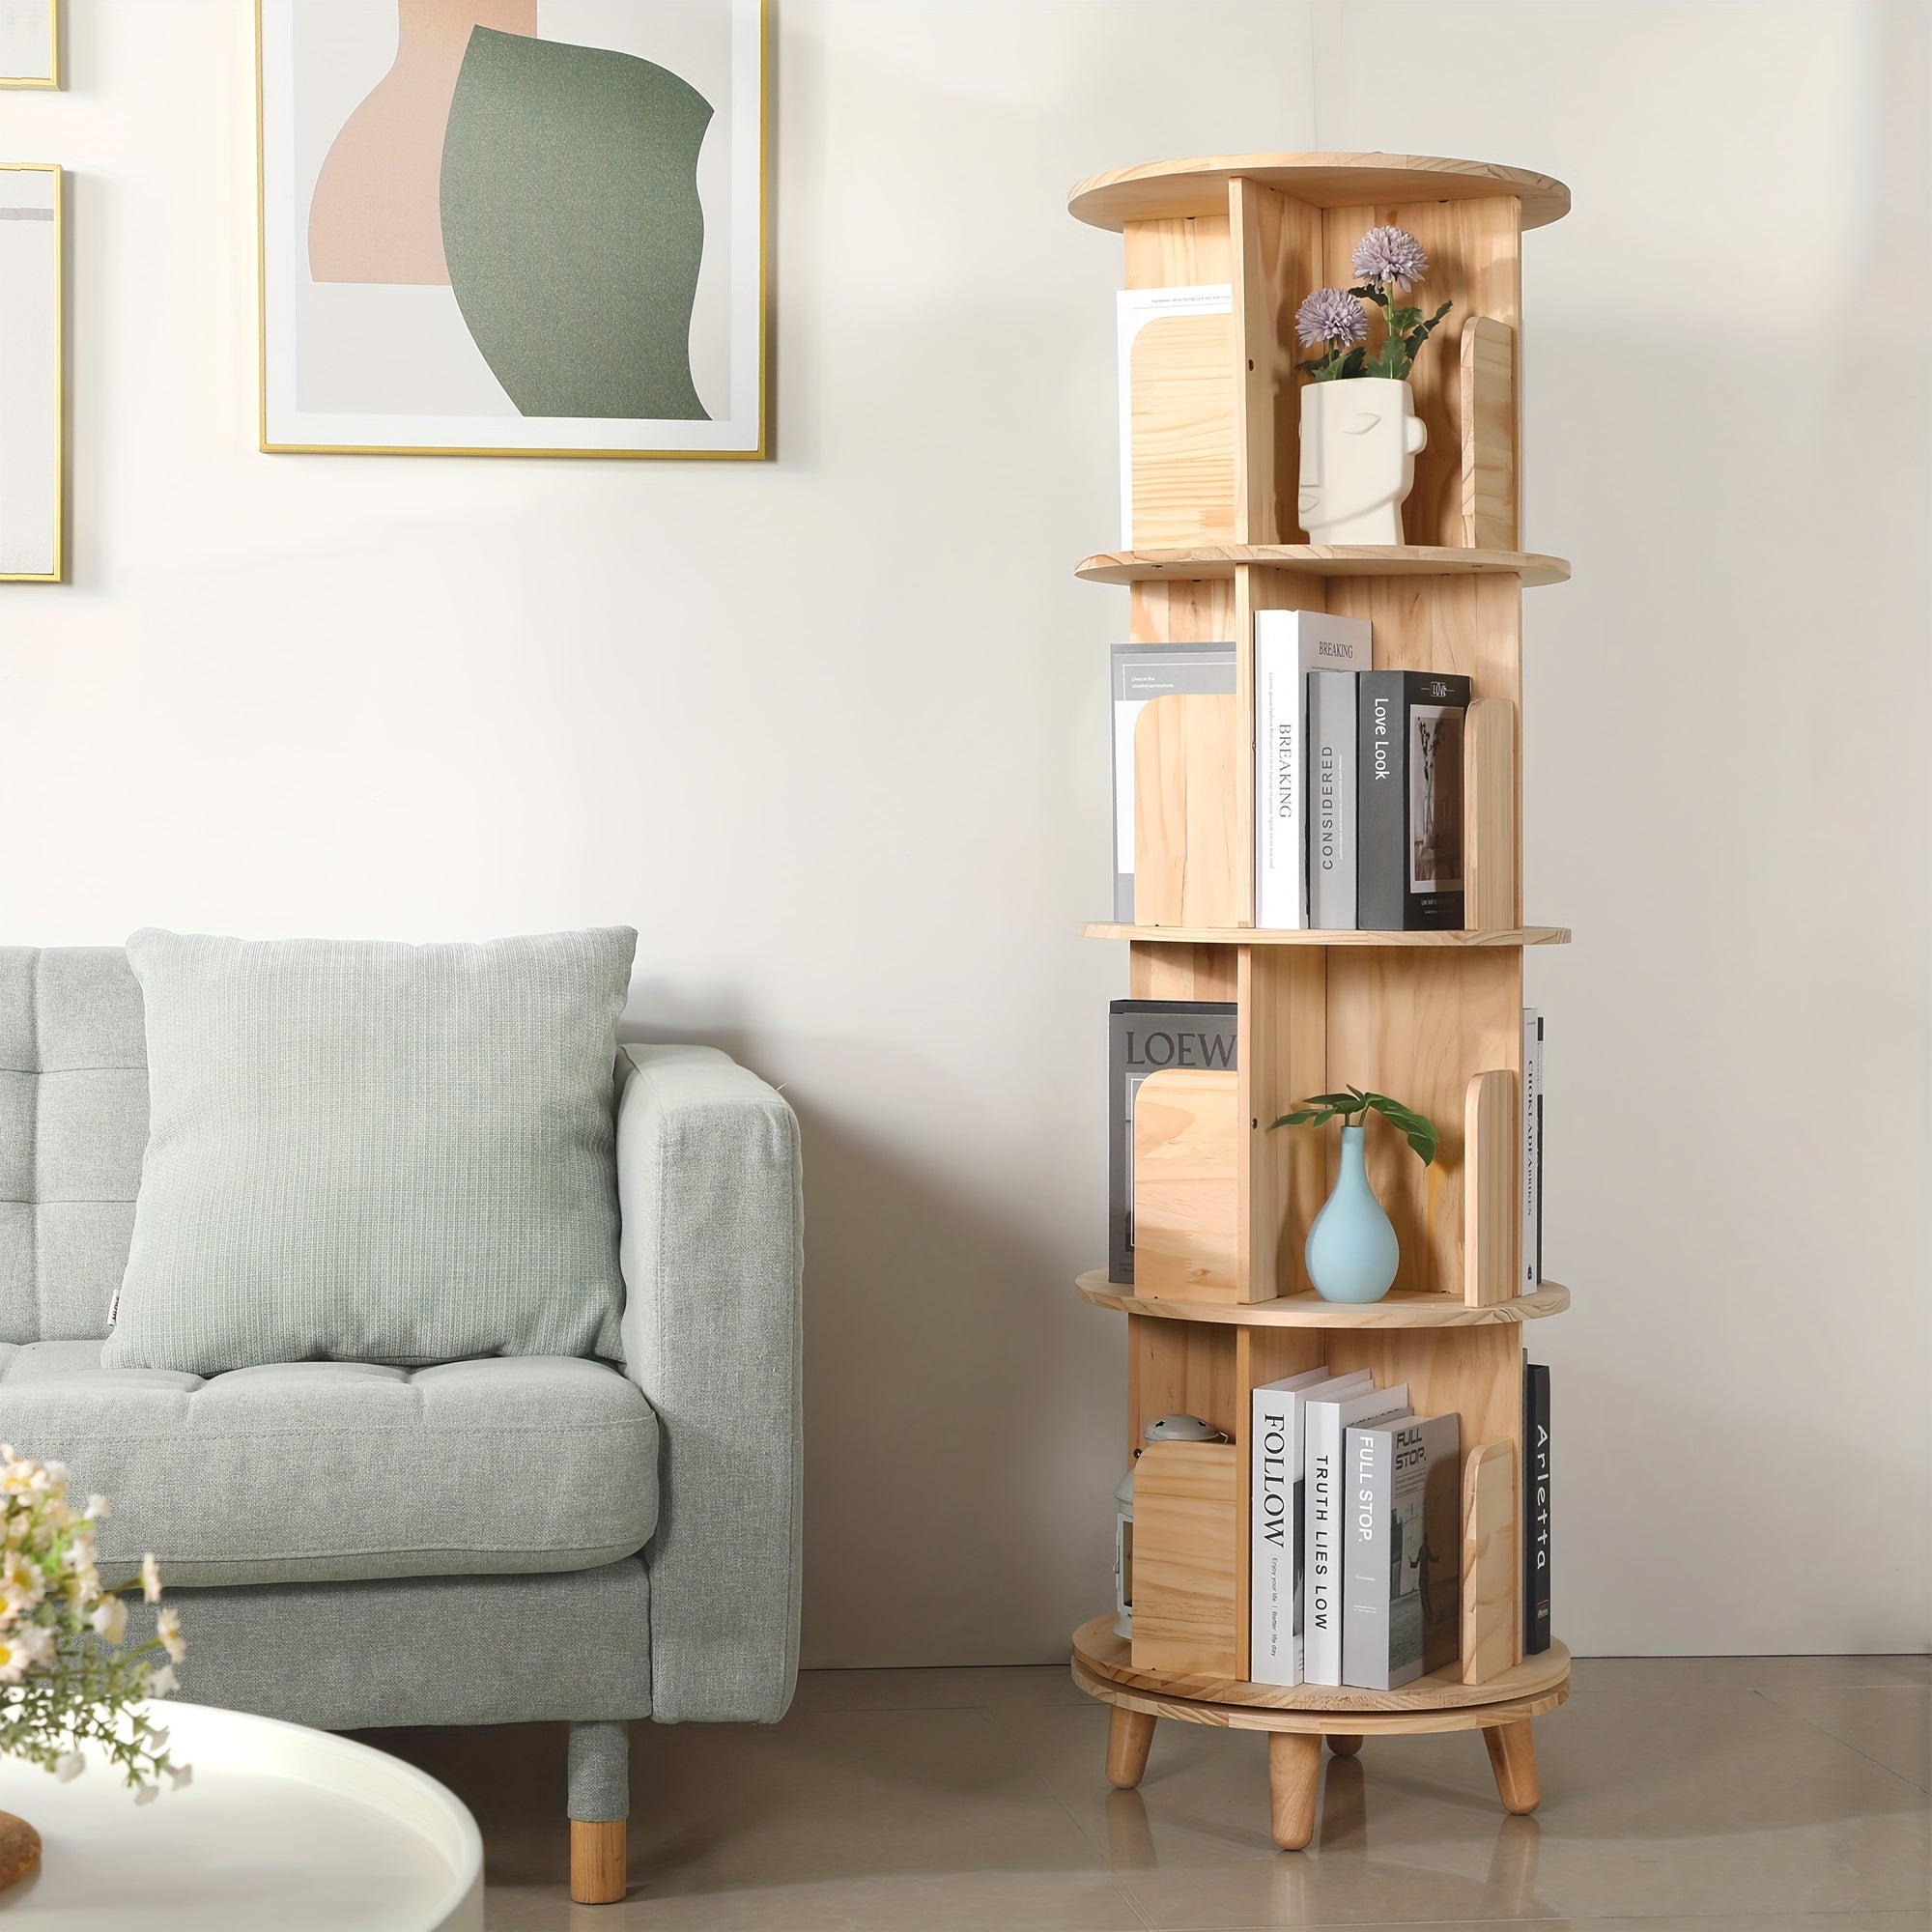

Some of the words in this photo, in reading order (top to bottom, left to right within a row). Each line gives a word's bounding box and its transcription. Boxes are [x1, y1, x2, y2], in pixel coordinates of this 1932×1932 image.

[1319, 641, 1353, 659] BREAKING
[1375, 698, 1389, 735] Love
[1279, 724, 1292, 818] BREAKING
[1375, 741, 1390, 781] Look
[1321, 747, 1333, 870] CONSIDERED
[1359, 1436, 1374, 1484] FULL
[1396, 1446, 1427, 1470] STOP.
[1397, 1428, 1423, 1449] FULL
[1264, 1413, 1285, 1548] FOLLOW
[1316, 1455, 1328, 1520] TRUTH
[1537, 1424, 1549, 1570] Arletta
[1358, 1489, 1374, 1542] STOP.
[1315, 1531, 1328, 1576] LIES
[1315, 1585, 1327, 1630] LOW
